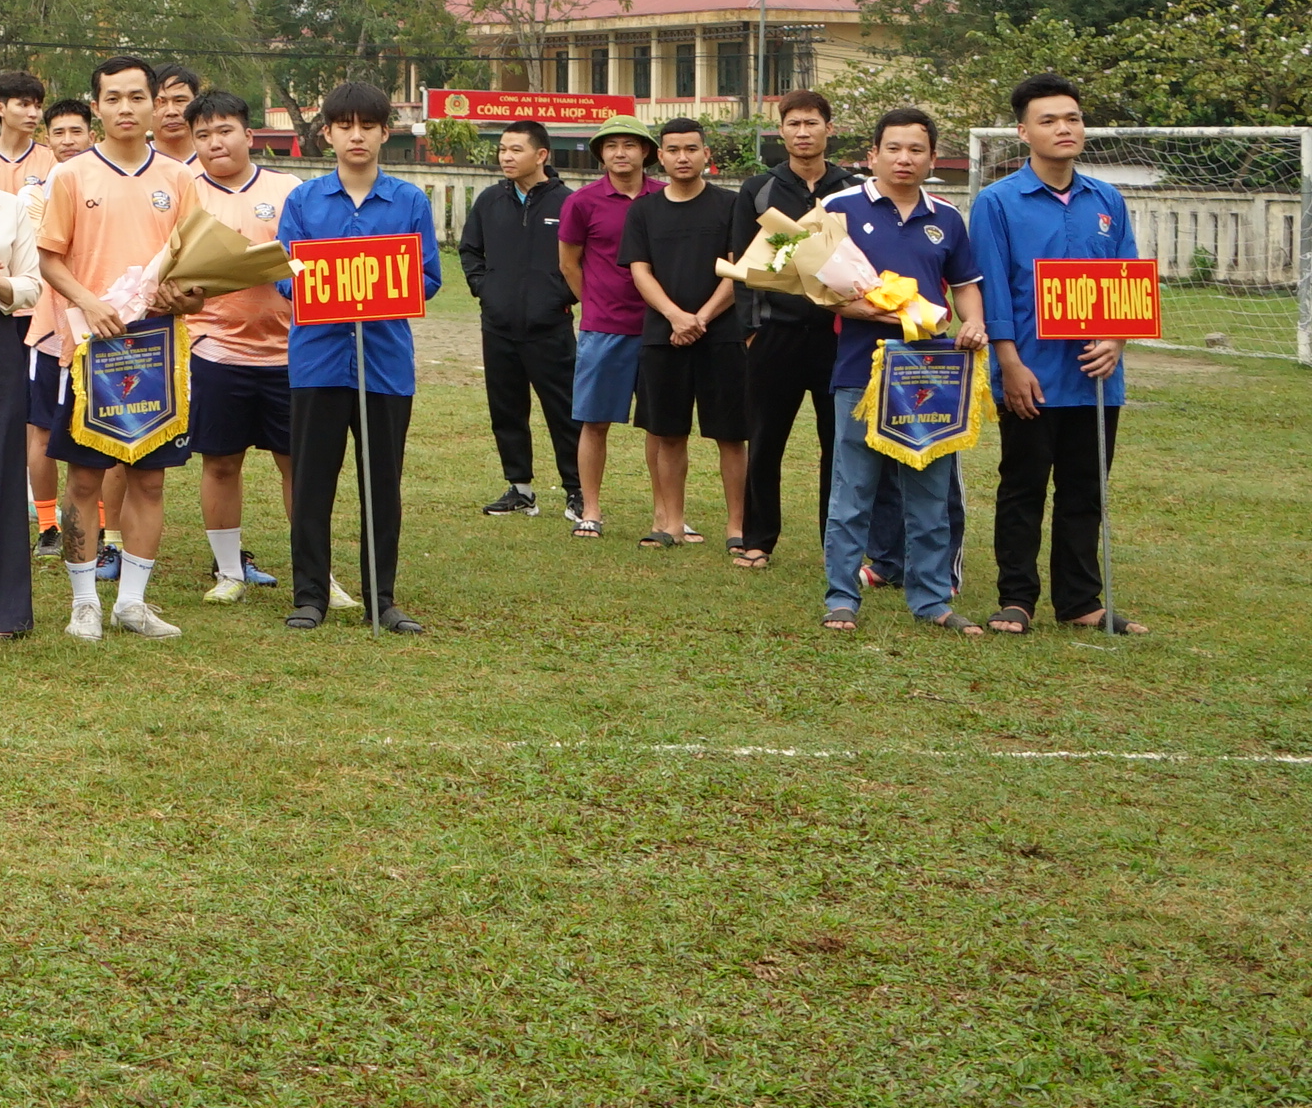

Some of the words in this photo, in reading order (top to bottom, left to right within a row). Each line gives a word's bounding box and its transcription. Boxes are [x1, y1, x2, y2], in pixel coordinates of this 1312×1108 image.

[476, 103, 510, 116] CÔNG
[514, 106, 533, 116] AN
[537, 105, 556, 117] XÃ
[561, 106, 586, 120] HỢP
[590, 105, 617, 118] TIẾN
[303, 259, 331, 304] FC
[336, 252, 379, 310] HỢP
[386, 245, 410, 298] LÝ
[1042, 278, 1062, 320] FC
[1066, 274, 1097, 329] HỢP
[1100, 262, 1152, 320] THẮNG
[99, 405, 124, 417] LƯU
[126, 400, 160, 414] NIỆM
[891, 415, 915, 425] LƯU
[918, 412, 951, 424] NIỆM
